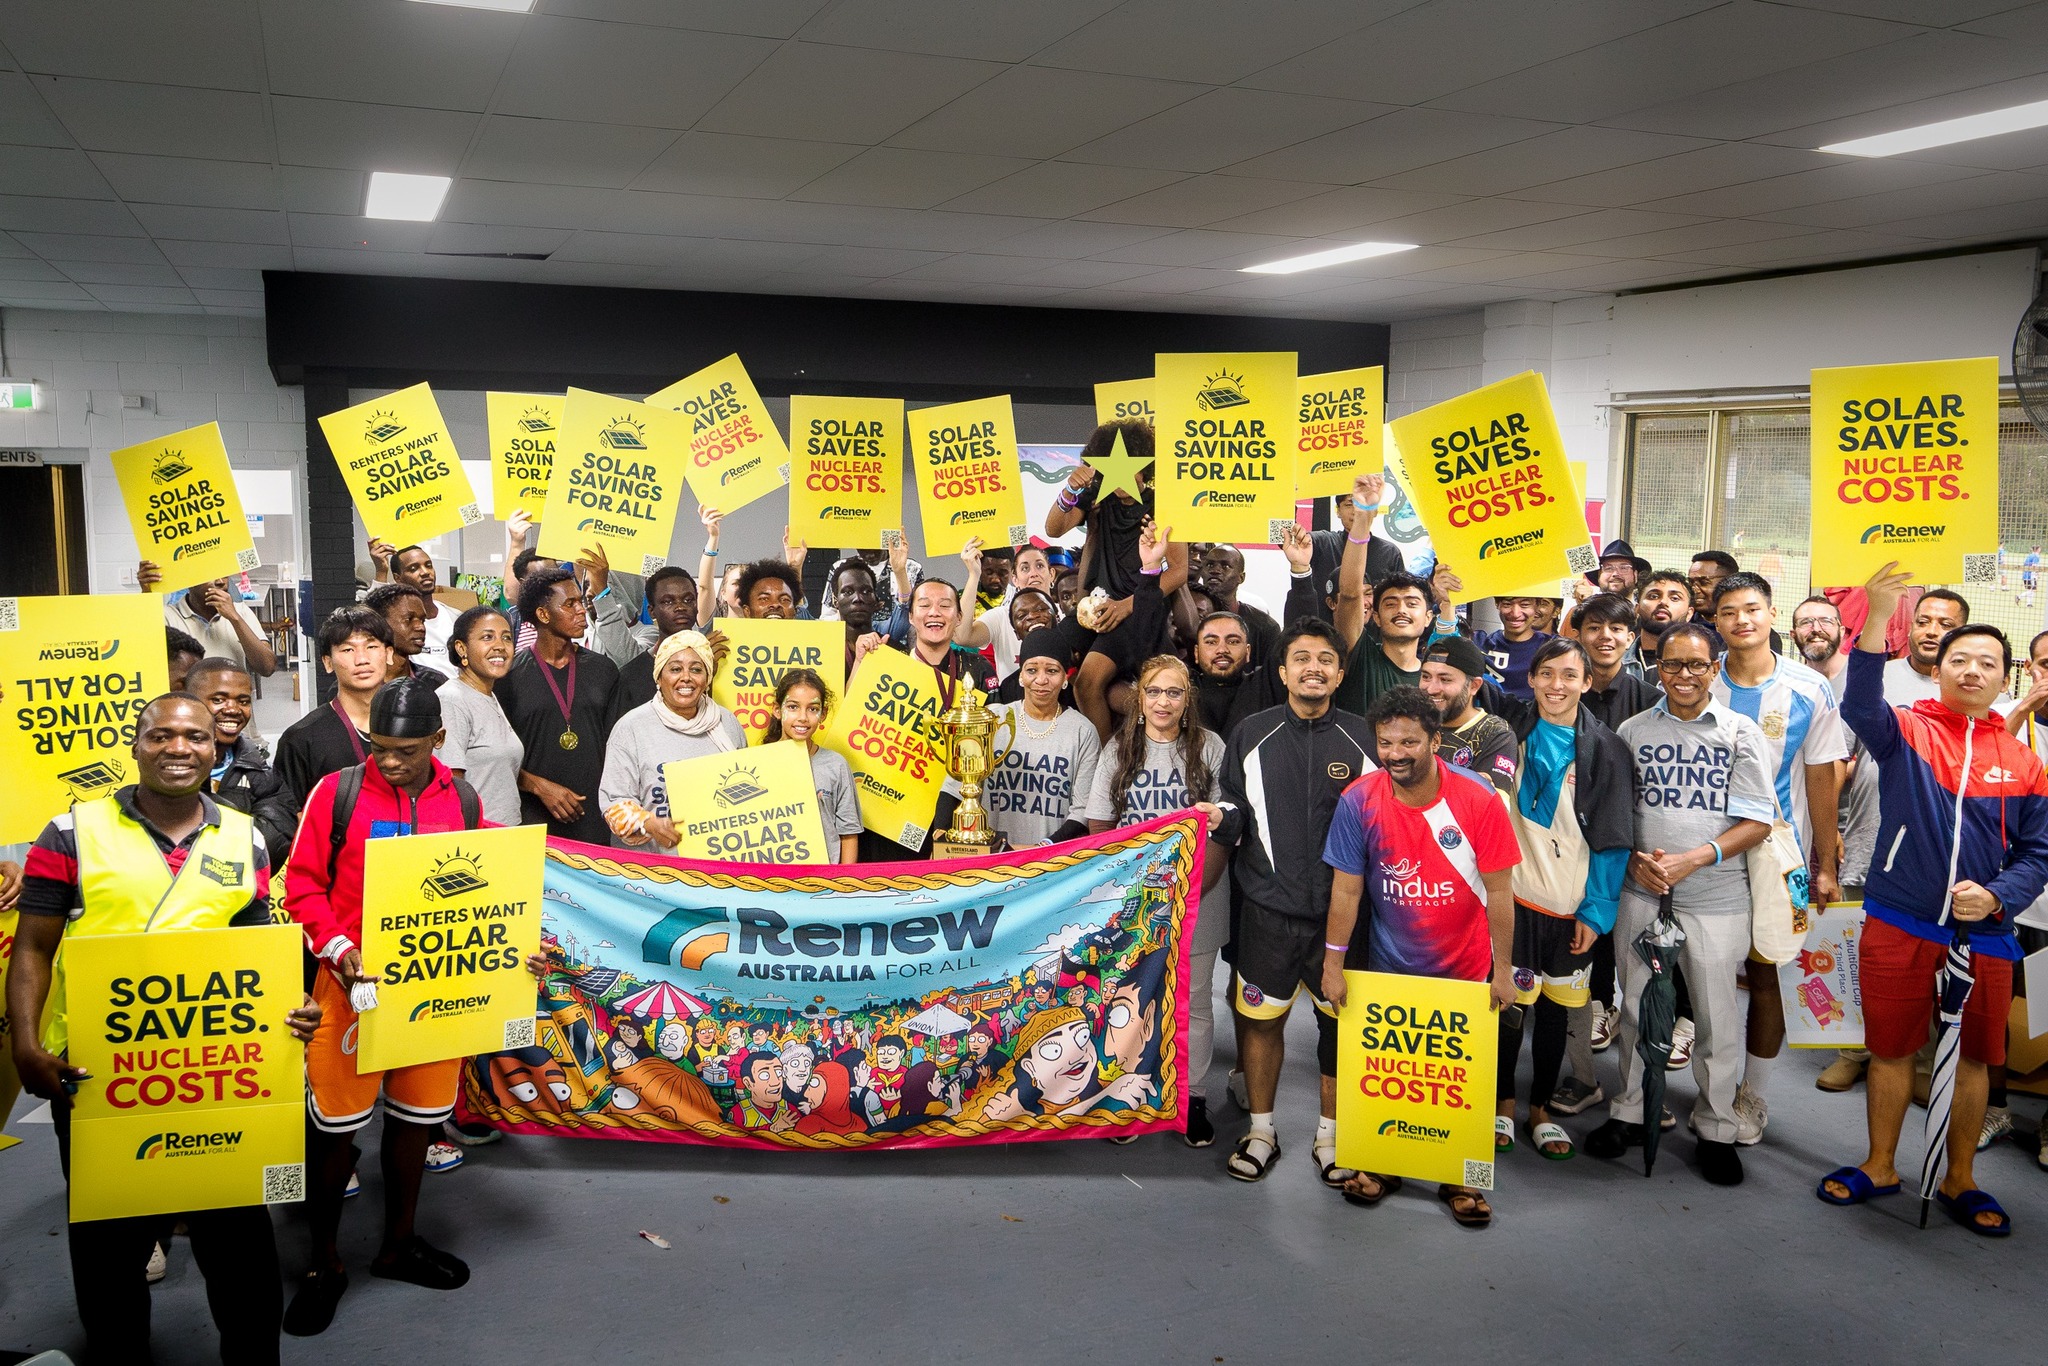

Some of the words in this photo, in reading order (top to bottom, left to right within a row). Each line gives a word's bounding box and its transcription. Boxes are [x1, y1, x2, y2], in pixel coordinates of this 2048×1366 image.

[674, 381, 736, 415] OLAR
[1115, 400, 1155, 418] SOL
[1301, 388, 1366, 407] SOLAR
[1842, 394, 1965, 423] SOLAR
[693, 398, 747, 434] AVES.
[1299, 402, 1368, 422] SAVES.
[690, 414, 752, 452] NUCLEAR
[810, 419, 884, 437] SOLAR
[929, 421, 996, 446] SOLAR
[1184, 420, 1266, 438] SOLAR
[1302, 420, 1366, 436] NUCLEAR
[1431, 412, 1530, 458] SOLAR
[1838, 421, 1969, 452] SAVES.
[350, 445, 404, 471] RENTERS
[404, 433, 438, 452] WANT
[511, 439, 556, 452] SOLA
[694, 427, 763, 467] COSTS.
[807, 438, 886, 457] SAVES.
[929, 439, 1001, 465] SAVES.
[1174, 440, 1276, 458] SAVINGS
[1298, 432, 1368, 452] COSTS.
[367, 449, 436, 482] SOLAR
[505, 452, 553, 466] SAVIN
[582, 452, 656, 482] SOLAR
[729, 457, 761, 477] Renew
[810, 461, 882, 473] NUCLEAR
[934, 461, 1001, 481] NUCLEAR
[1176, 462, 1225, 480] FOR
[1230, 462, 1274, 480] ALL
[1322, 459, 1356, 469] Renew
[1435, 437, 1540, 484] SAVES.
[1844, 454, 1964, 475] NUCLEAR
[366, 462, 450, 501] SAVINGS
[507, 467, 541, 480] FOR
[569, 469, 662, 501] SAVINGS
[806, 474, 886, 493] COSTS.
[1446, 465, 1542, 504] NUCLEAR
[149, 480, 212, 509] SOLAR
[933, 474, 1006, 500] COSTS.
[1209, 490, 1256, 502] Renew
[1838, 475, 1969, 504] COSTS.
[146, 493, 225, 527] SAVINGS
[406, 494, 442, 512] Renew
[567, 488, 613, 512] FOR
[616, 500, 657, 521] ALL
[834, 506, 871, 516] Renew
[961, 508, 996, 520] Renew
[1448, 483, 1555, 528] COSTS.
[152, 522, 192, 544] FOR
[196, 511, 230, 532] ALL
[594, 520, 637, 537] Renew
[1494, 529, 1544, 549] Renew
[1883, 524, 1946, 538] Renew
[184, 537, 221, 553] Renew
[1498, 545, 1524, 556] AUSTRALIA
[39, 647, 98, 661] Renew
[736, 645, 822, 665] SOLAR
[16, 676, 74, 702] ALL
[81, 672, 142, 696] FOR
[733, 666, 816, 688] SAV
[876, 674, 941, 718] SOLA
[17, 698, 148, 731] SAVINGS
[32, 724, 137, 755] SOLAR
[859, 714, 935, 761] NUCLEAR
[848, 730, 929, 783] COSTS.
[994, 750, 1069, 777] SOLAR
[1638, 744, 1730, 768] SOLAR
[863, 774, 905, 801] Renew
[987, 771, 1072, 799] SAVINGS
[1132, 768, 1184, 788] OLA
[990, 792, 1026, 813] FOR
[1030, 796, 1064, 818] ALL
[688, 812, 758, 836] RENTERS
[760, 802, 805, 821] WANT
[707, 822, 796, 856] SOLAR
[1383, 876, 1454, 898] indus
[1383, 896, 1455, 906] MORTGAGES
[381, 908, 468, 932] RENTERS
[472, 902, 527, 920] WANT
[398, 923, 508, 957] SOLAR
[736, 904, 1004, 957] Renew
[384, 947, 519, 985] SAVINGS
[738, 963, 875, 982] AUSTRALIA
[886, 964, 936, 980] FOR
[939, 956, 981, 974] ALL
[1836, 952, 1844, 972] Third
[110, 969, 264, 1007] SOLAR
[1838, 974, 1847, 995] Place
[1851, 986, 1862, 1006] Cup
[431, 1010, 463, 1019] AUSTRALIA
[432, 995, 491, 1013] Renew
[105, 1002, 269, 1044] SAVES.
[908, 1021, 934, 1032] UNION
[1366, 1003, 1470, 1034] SOLAR
[1361, 1027, 1472, 1062] SAVES.
[113, 1042, 264, 1074] NUCLEAR
[1366, 1056, 1467, 1083] NUCLEAR
[106, 1068, 271, 1109] COSTS.
[1360, 1074, 1472, 1110] COSTS.
[166, 1131, 243, 1149] Renew
[1397, 1120, 1450, 1138] Renew
[165, 1149, 206, 1158] AUSTRALIA
